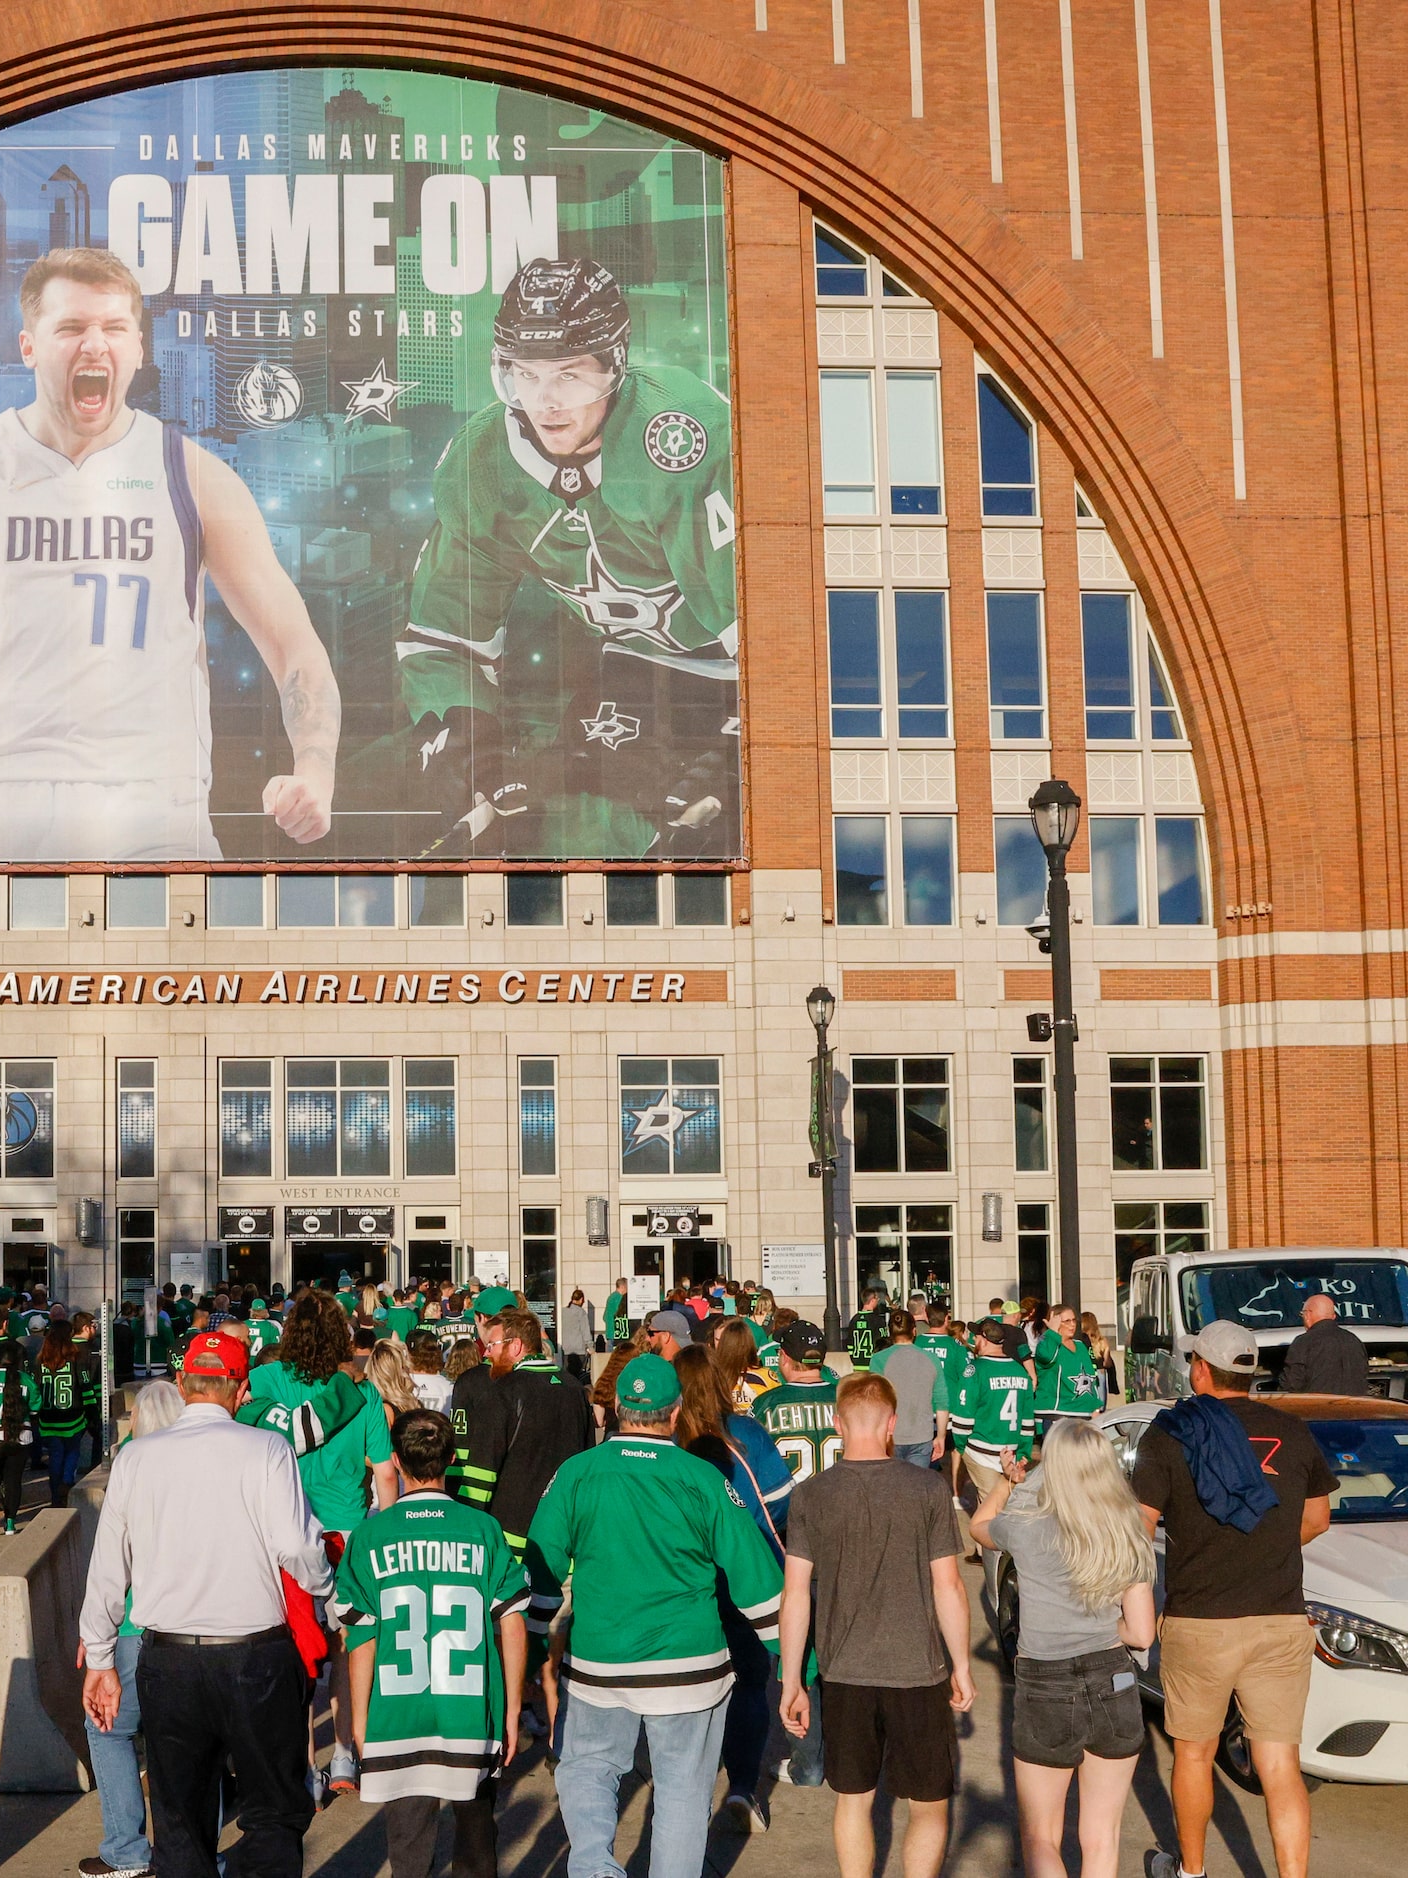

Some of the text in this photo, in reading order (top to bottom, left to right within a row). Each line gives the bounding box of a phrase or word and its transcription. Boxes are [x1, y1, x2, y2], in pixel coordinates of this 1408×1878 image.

[139, 133, 526, 161] DALLAS MAVERICKS
[108, 174, 558, 296] GAME ON
[178, 310, 463, 338] DALLAS STARS
[519, 329, 564, 341] CCM
[647, 416, 688, 457] DALLAS
[669, 430, 705, 468] STARS
[106, 476, 155, 490] chime
[6, 516, 154, 562] DALLAS
[74, 573, 151, 649] 77
[258, 970, 482, 1005] AIRLINES
[498, 969, 686, 1005] CENTER
[280, 1187, 401, 1199] WEST ENTRANCE
[1319, 1278, 1357, 1295] K9
[1328, 1301, 1375, 1319] NIT
[853, 1330, 873, 1358] 14
[959, 1389, 967, 1406] 4
[989, 1377, 1028, 1390] HEISKANEN
[1000, 1390, 1018, 1431] 4
[621, 1449, 658, 1460] Reebok
[405, 1509, 445, 1519] Reebok
[369, 1540, 485, 1580] LEHTONEN
[379, 1585, 484, 1696] 32
